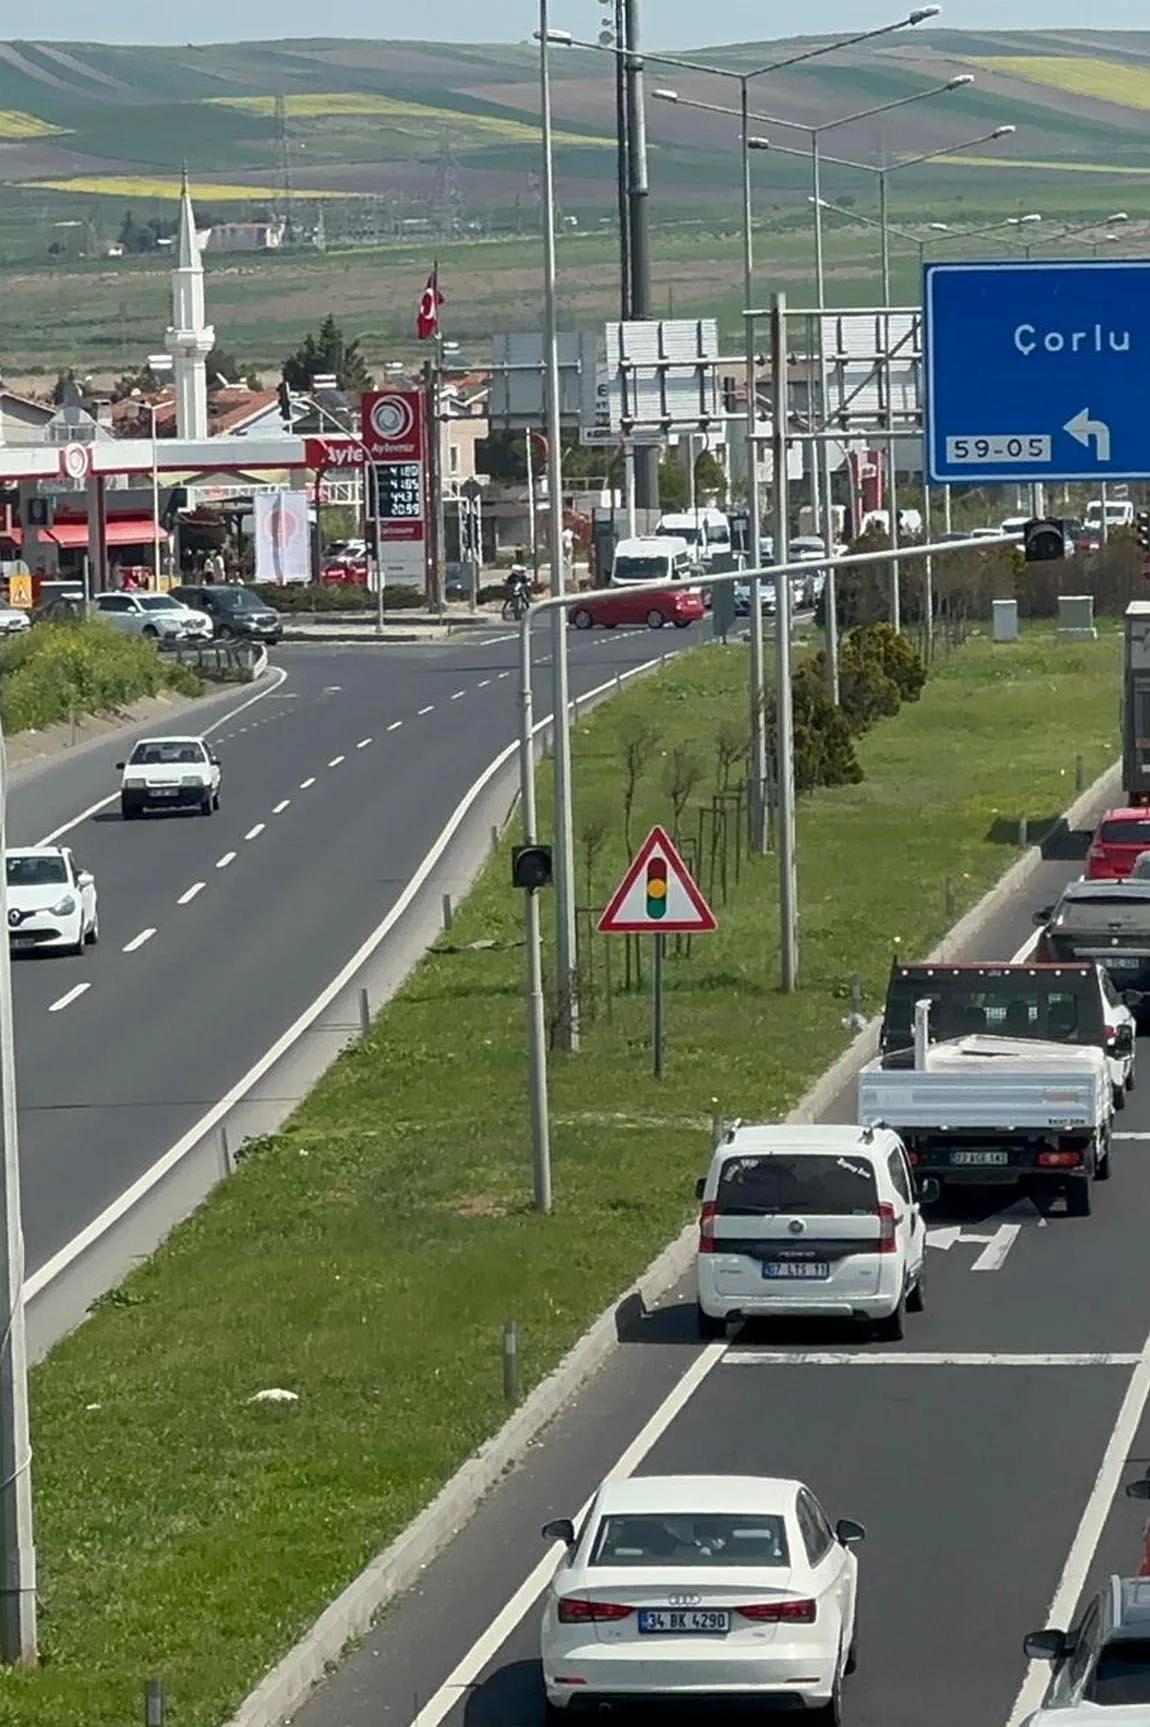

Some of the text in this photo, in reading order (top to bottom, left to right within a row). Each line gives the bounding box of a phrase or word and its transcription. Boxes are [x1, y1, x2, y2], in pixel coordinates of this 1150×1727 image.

[1014, 324, 1130, 355] Çorlu
[954, 439, 1043, 458] 59-05
[650, 1614, 725, 1628] 34 BK 4290
